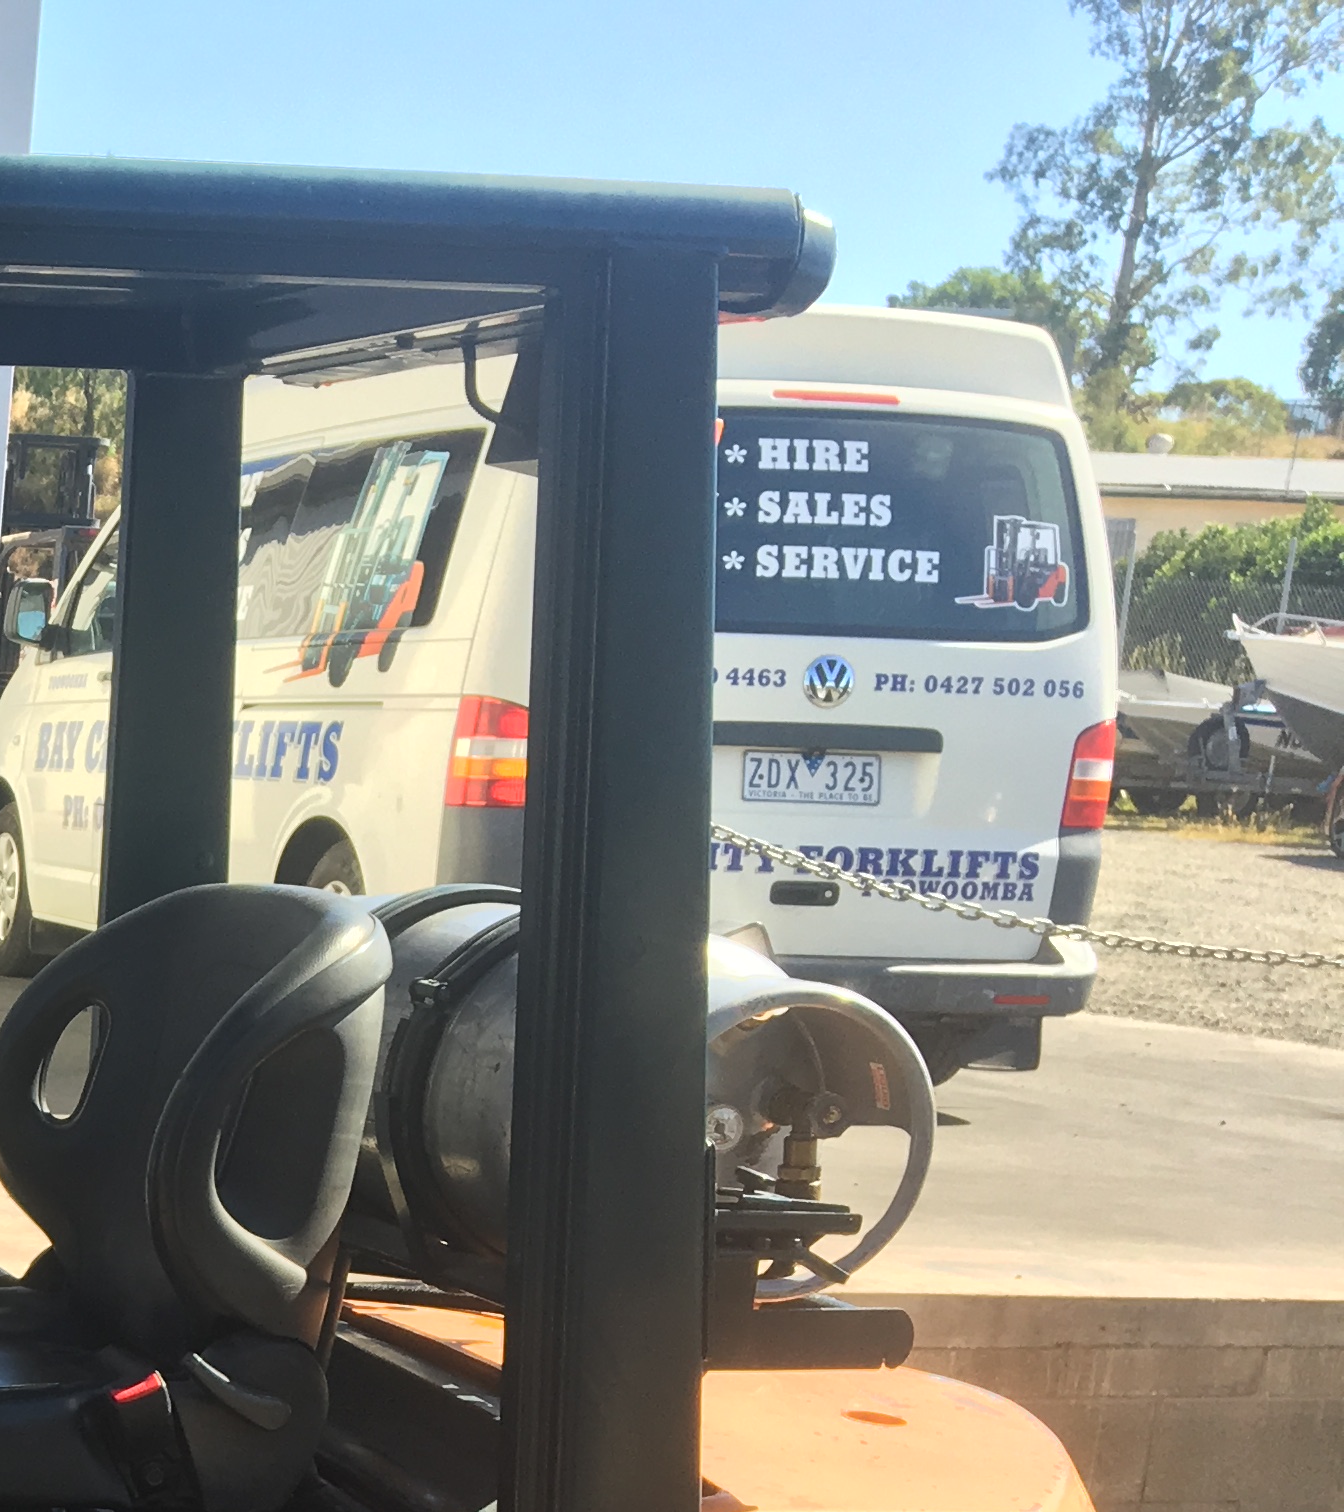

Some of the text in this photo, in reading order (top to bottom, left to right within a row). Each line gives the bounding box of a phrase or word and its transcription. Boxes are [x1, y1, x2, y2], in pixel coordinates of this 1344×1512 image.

[757, 437, 870, 473] HIRE
[757, 490, 892, 528] SALES
[755, 544, 941, 584] SERVICE
[725, 667, 788, 688] 4463
[874, 673, 1086, 699] PH: 0427 502 056
[34, 720, 84, 772] BAY
[232, 719, 345, 785] LIFTS
[748, 757, 874, 792] ZDX 325
[748, 789, 787, 798] VICTORIA
[799, 791, 814, 800] THE
[818, 792, 844, 801] PLACE
[847, 793, 859, 801] TO
[793, 845, 1040, 881] FORKLIFTS
